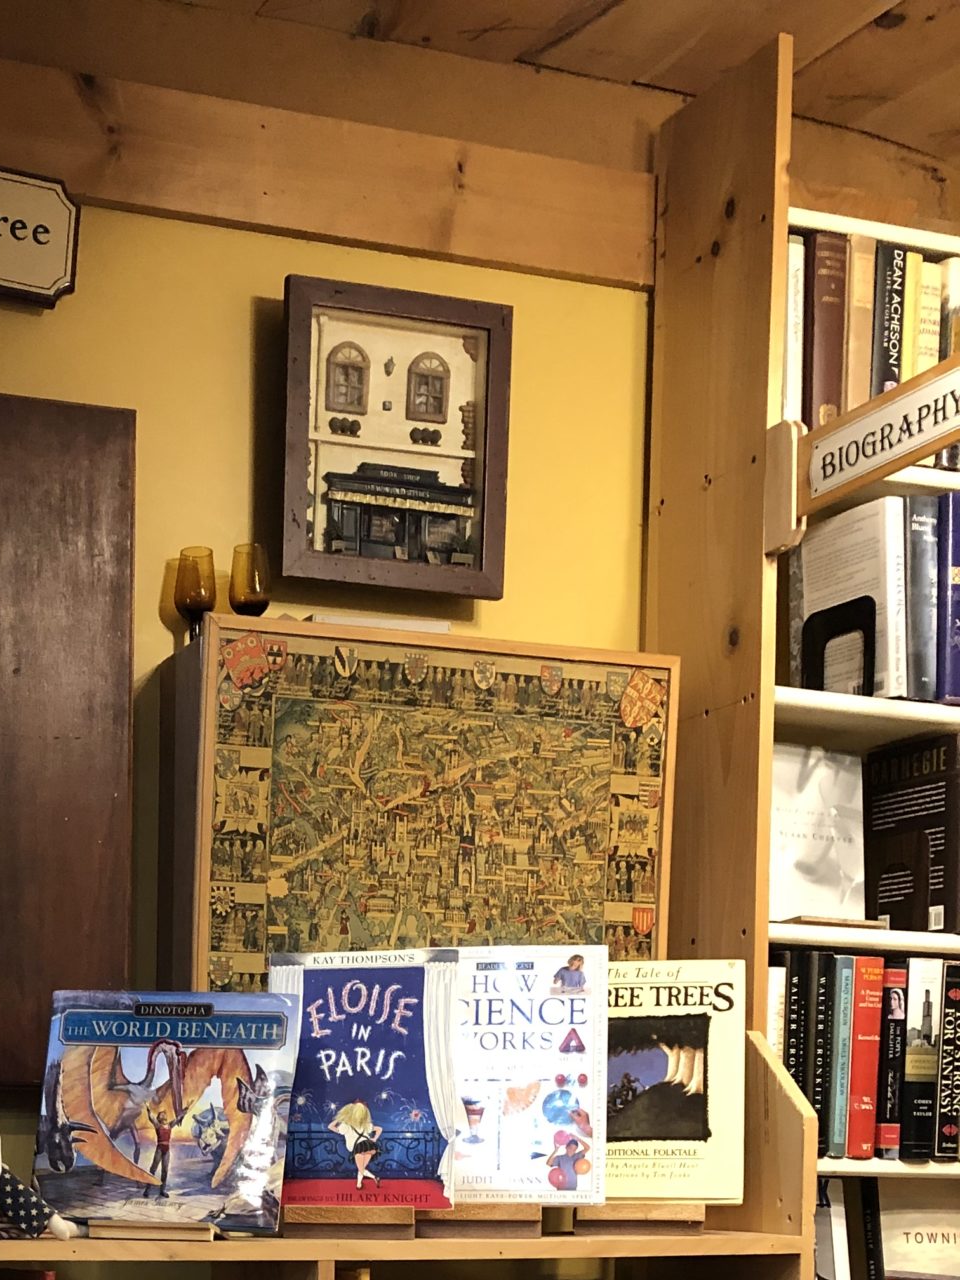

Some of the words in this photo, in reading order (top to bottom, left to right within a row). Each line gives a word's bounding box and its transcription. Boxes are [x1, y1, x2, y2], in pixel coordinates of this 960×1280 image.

[893, 250, 903, 289] DEAN
[889, 293, 901, 364] ACHESON
[820, 389, 960, 482] BIOGRAPHY
[313, 956, 335, 965] KAY
[340, 954, 415, 964] THOMPSON'S
[609, 968, 628, 979] The
[635, 968, 660, 979] Tale
[667, 967, 682, 981] of
[140, 1006, 207, 1016] DINOTOPIA
[307, 979, 419, 1038] ELOISE
[790, 976, 799, 1030] WALTER
[818, 976, 827, 1030] WALTER
[67, 1026, 89, 1036] THE
[91, 1020, 170, 1039] WORLD
[176, 1022, 280, 1040] BENEATH
[351, 1023, 372, 1043] IN
[944, 1008, 955, 1038] FOR
[317, 1047, 406, 1082] PARIS
[814, 1038, 823, 1110] CRONKITE
[941, 1044, 953, 1116] FANTASY
